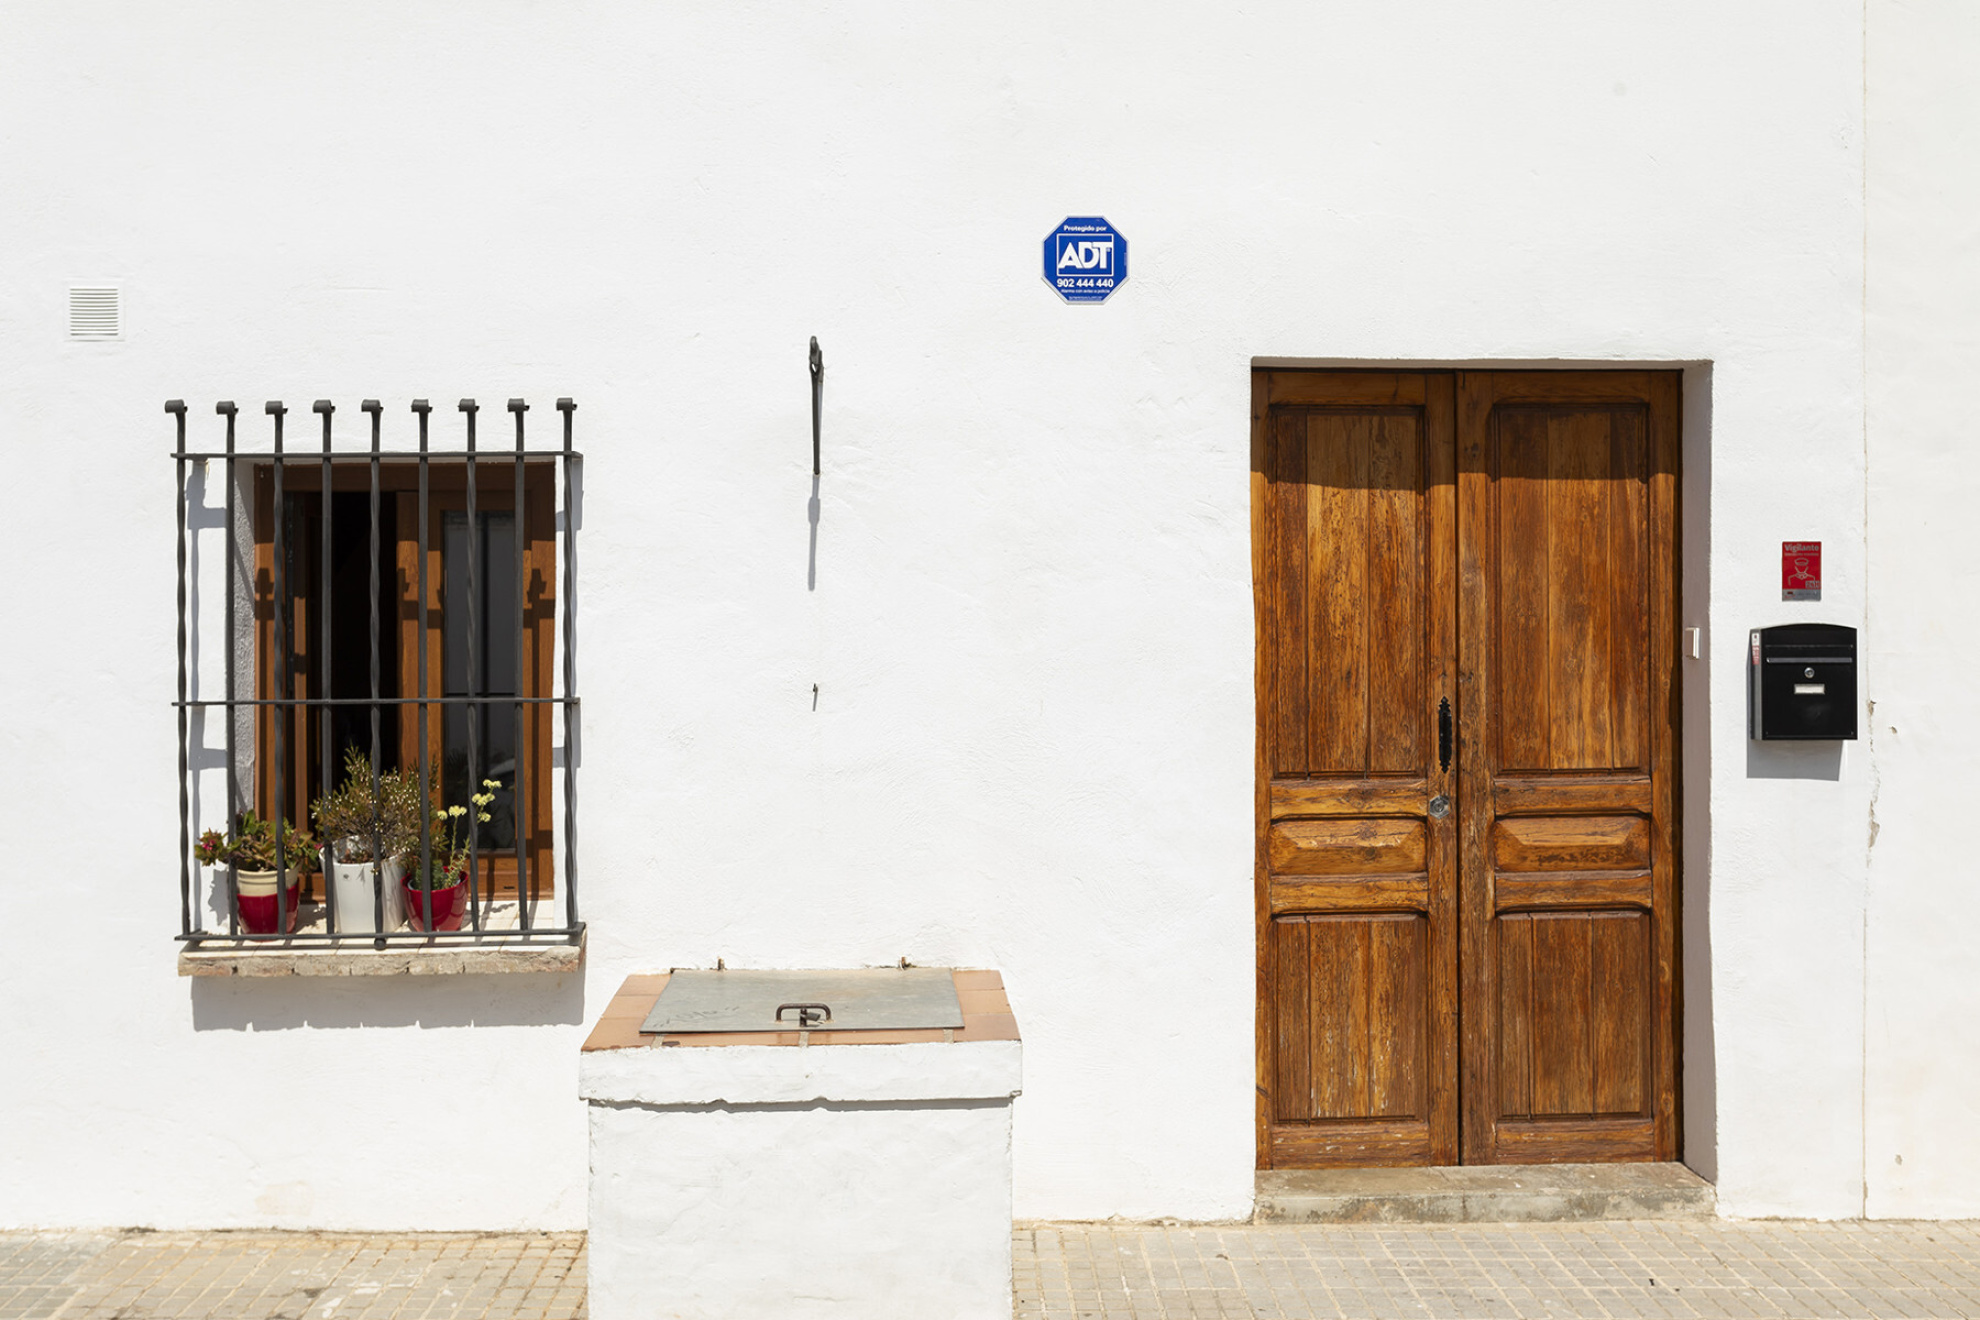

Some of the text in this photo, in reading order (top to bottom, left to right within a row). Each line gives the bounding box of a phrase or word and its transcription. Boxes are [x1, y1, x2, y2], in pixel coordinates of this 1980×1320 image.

[1058, 242, 1113, 269] ADT
[1057, 278, 1114, 288] 902 444 440
